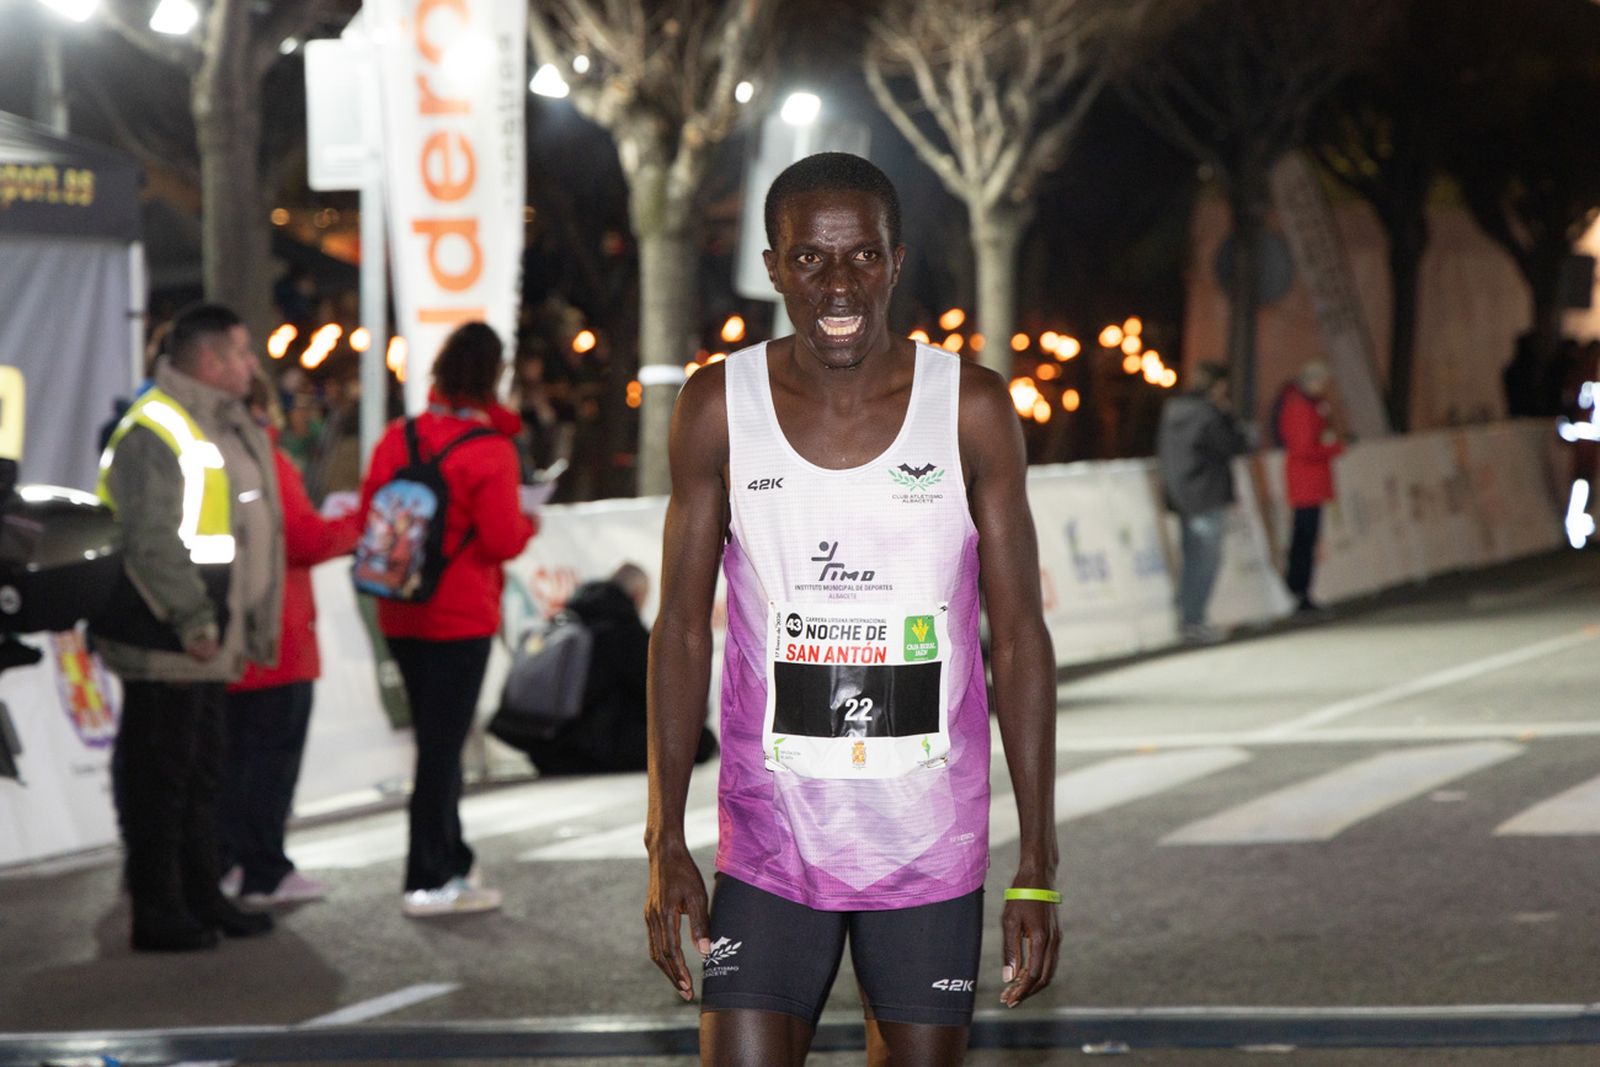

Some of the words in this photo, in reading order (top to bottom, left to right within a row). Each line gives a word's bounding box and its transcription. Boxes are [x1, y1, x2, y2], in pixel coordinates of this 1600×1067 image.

[747, 477, 784, 491] 42K
[828, 592, 857, 600] ALBACETE
[787, 618, 802, 632] 43
[806, 624, 861, 640] NOCHE
[866, 626, 887, 641] DE
[786, 644, 820, 663] SAN
[824, 642, 887, 663] ANTÓN
[845, 698, 873, 721] 22
[932, 979, 974, 992] 42K
